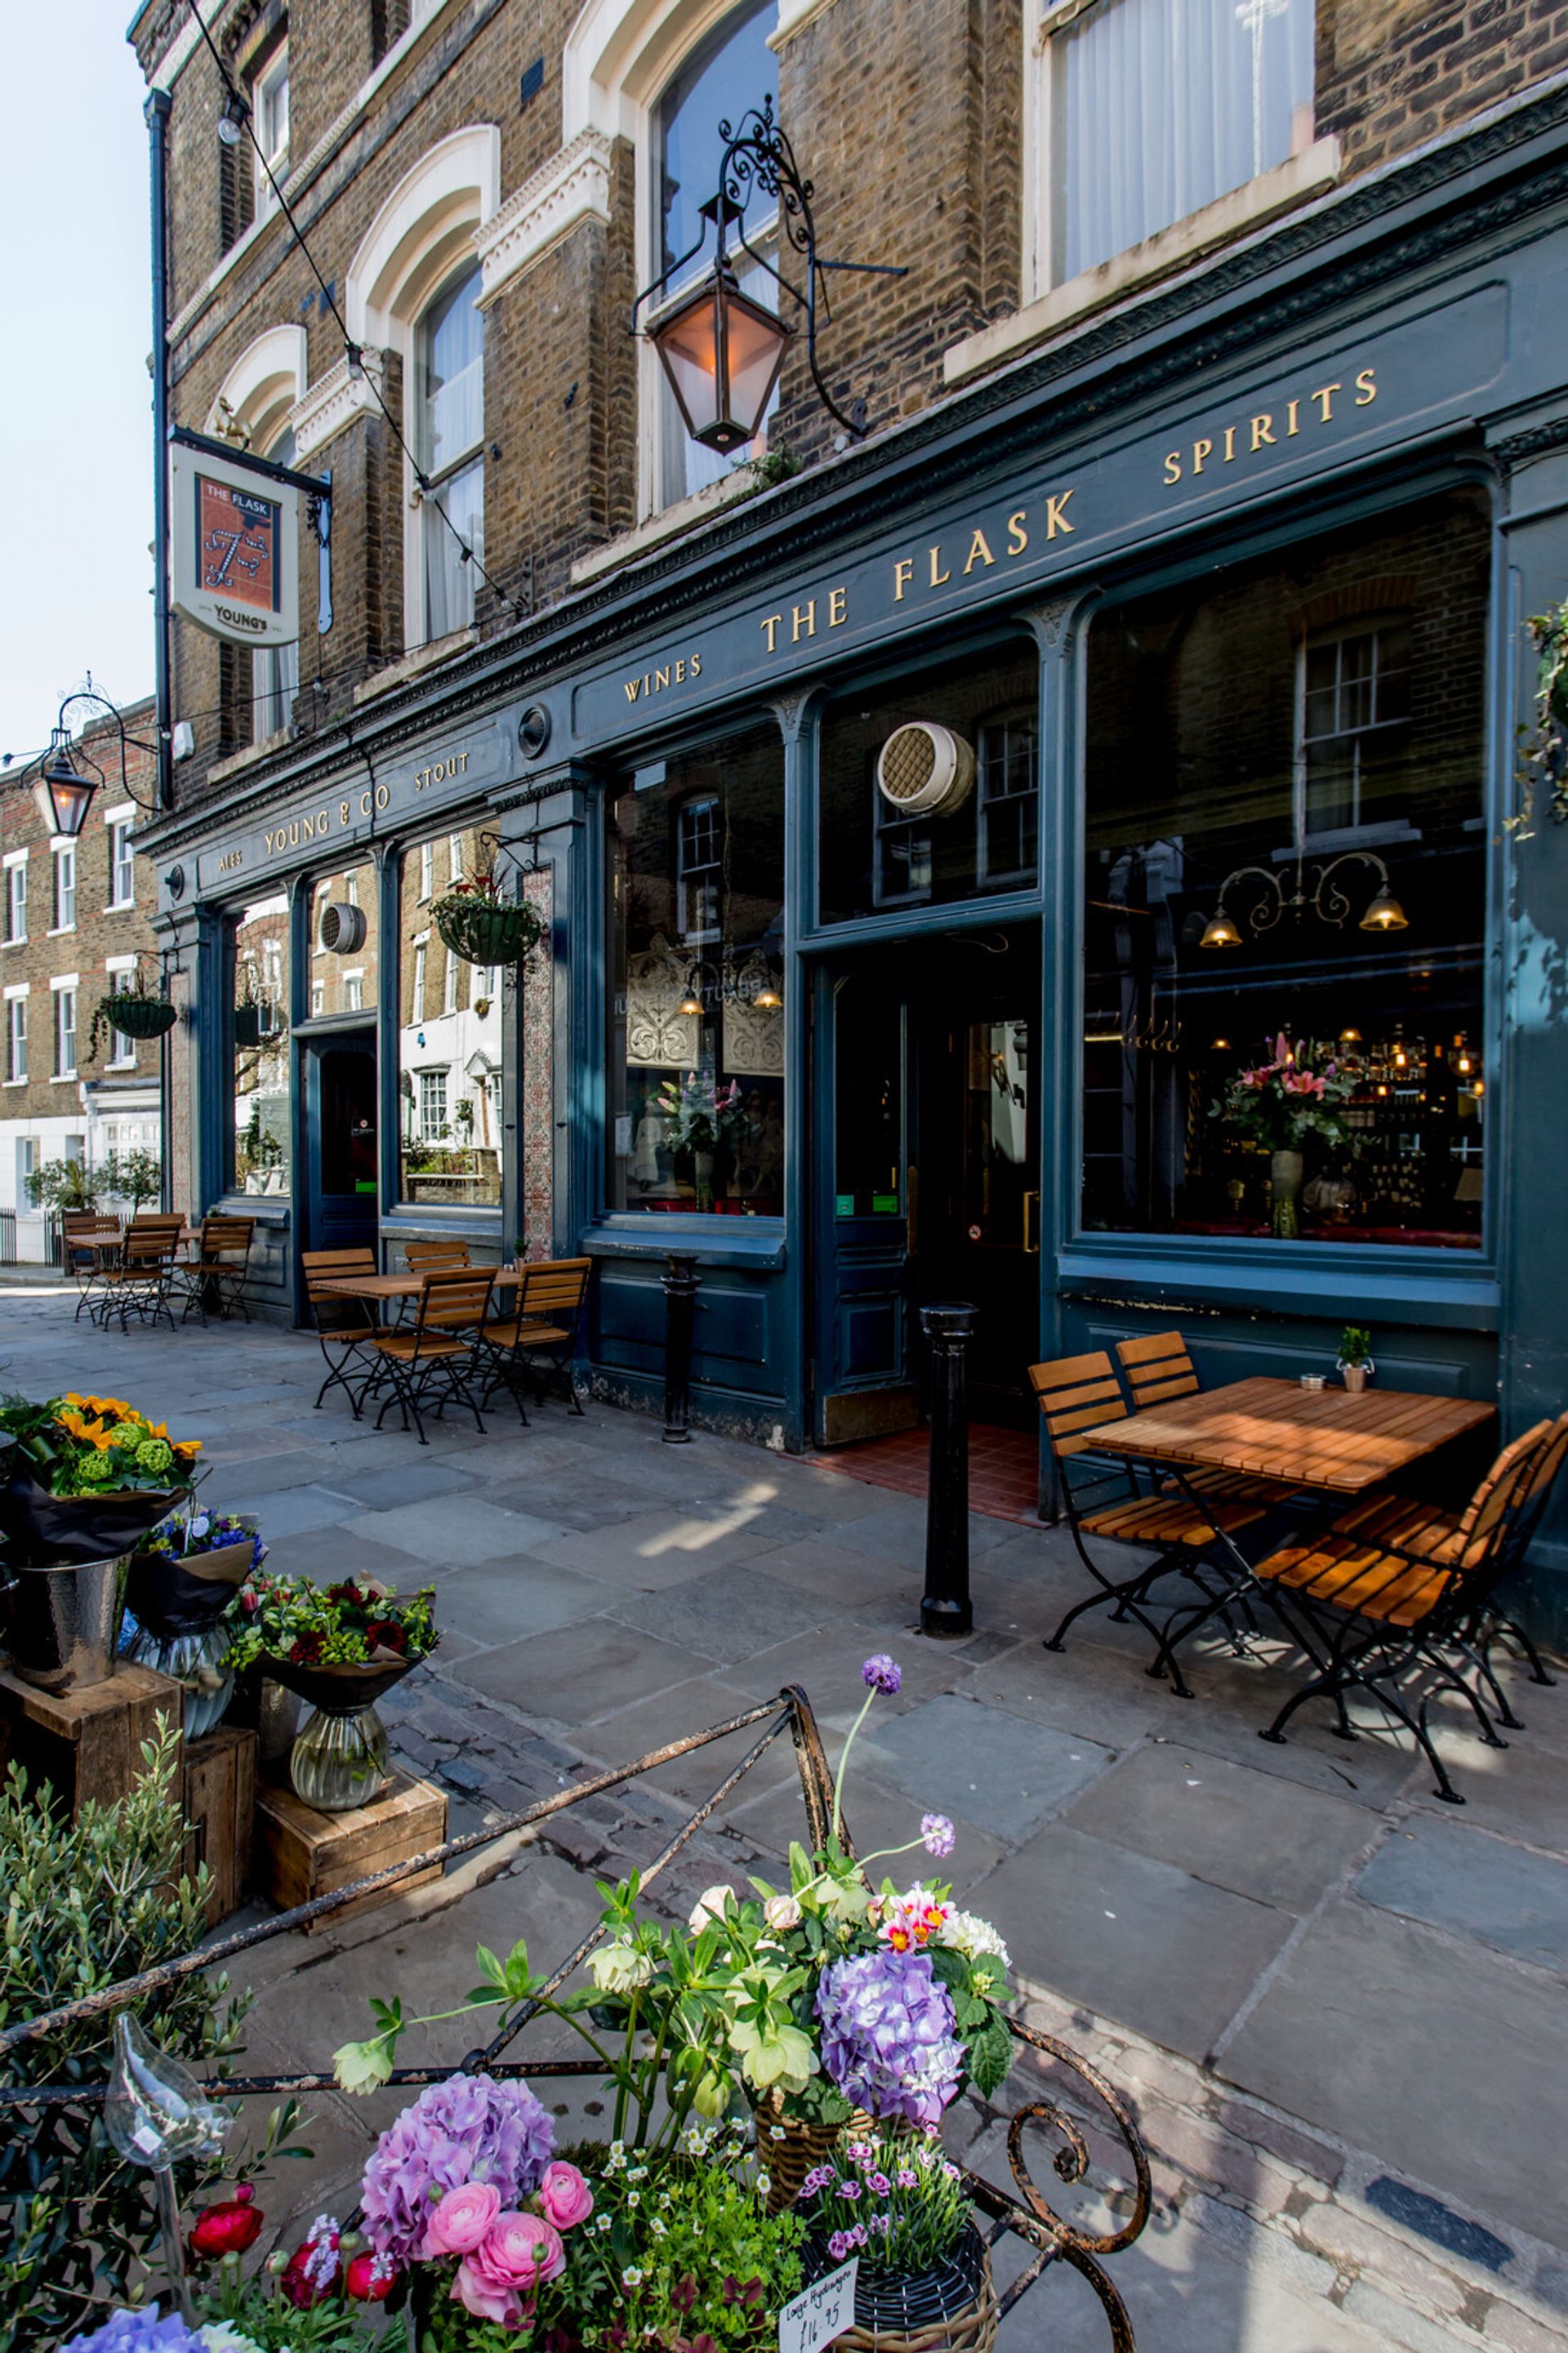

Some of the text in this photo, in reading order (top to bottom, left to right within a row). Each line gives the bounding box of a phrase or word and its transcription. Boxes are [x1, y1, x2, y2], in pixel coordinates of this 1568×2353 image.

[207, 483, 268, 515] THE FLASK
[624, 368, 1378, 703] WINES THE FLASK SPIRITS
[214, 604, 267, 631] YOUNG'S
[219, 753, 469, 871] ALES YOUNG & CO STOUT
